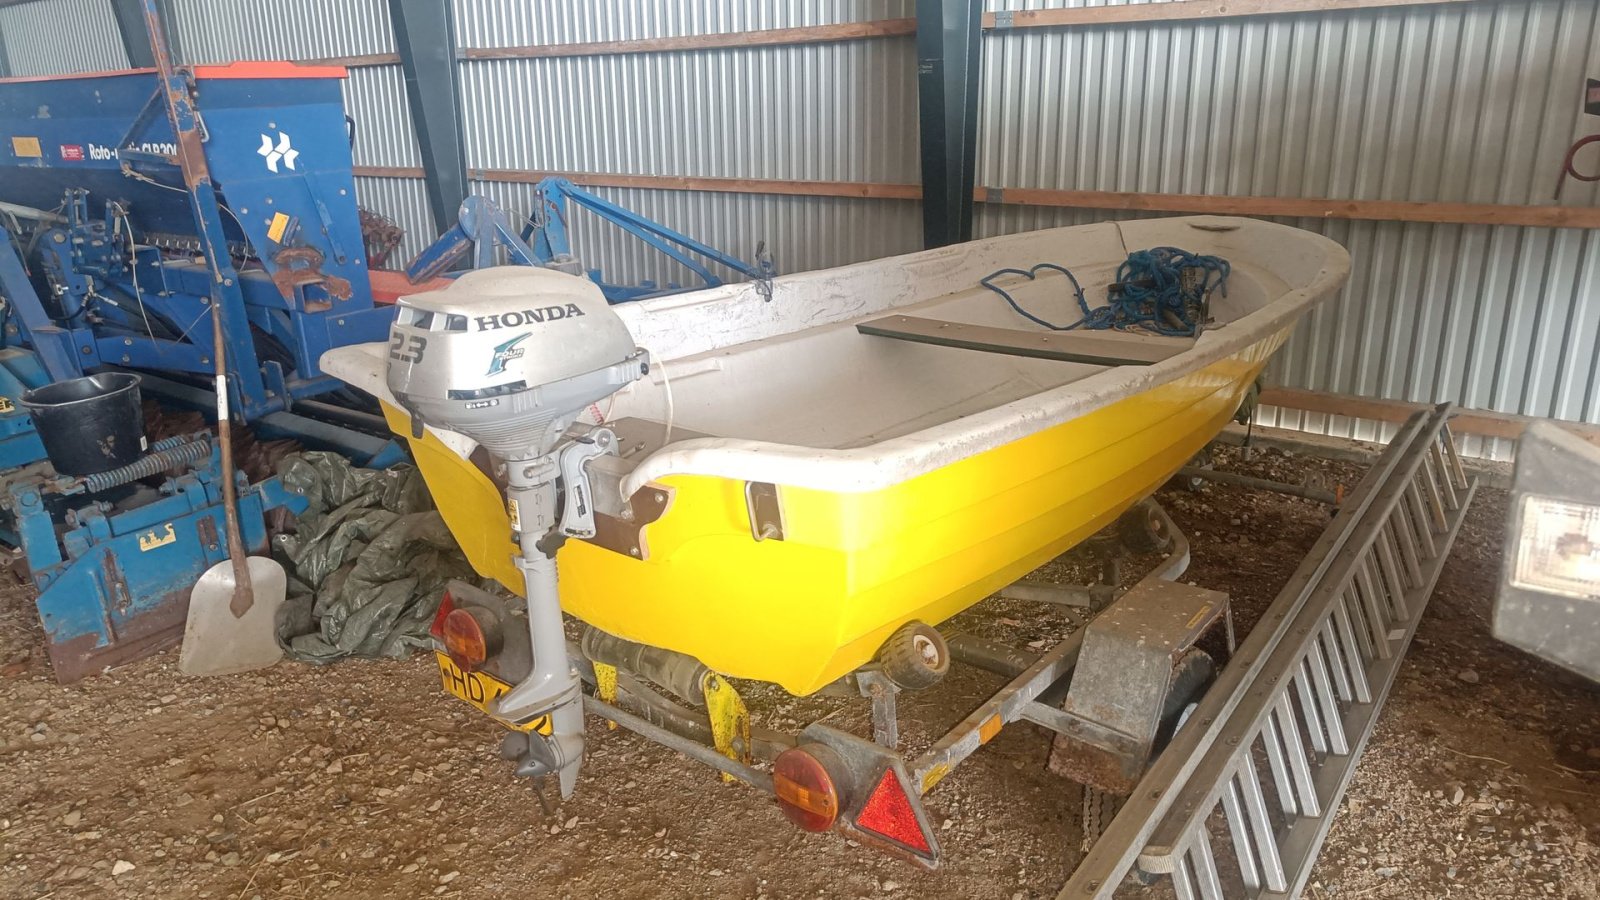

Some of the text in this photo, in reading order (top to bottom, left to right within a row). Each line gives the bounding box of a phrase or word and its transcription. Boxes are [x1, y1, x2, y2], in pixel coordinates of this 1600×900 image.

[474, 303, 585, 332] HONDA
[495, 348, 525, 359] FOUR
[450, 663, 485, 704] HD
